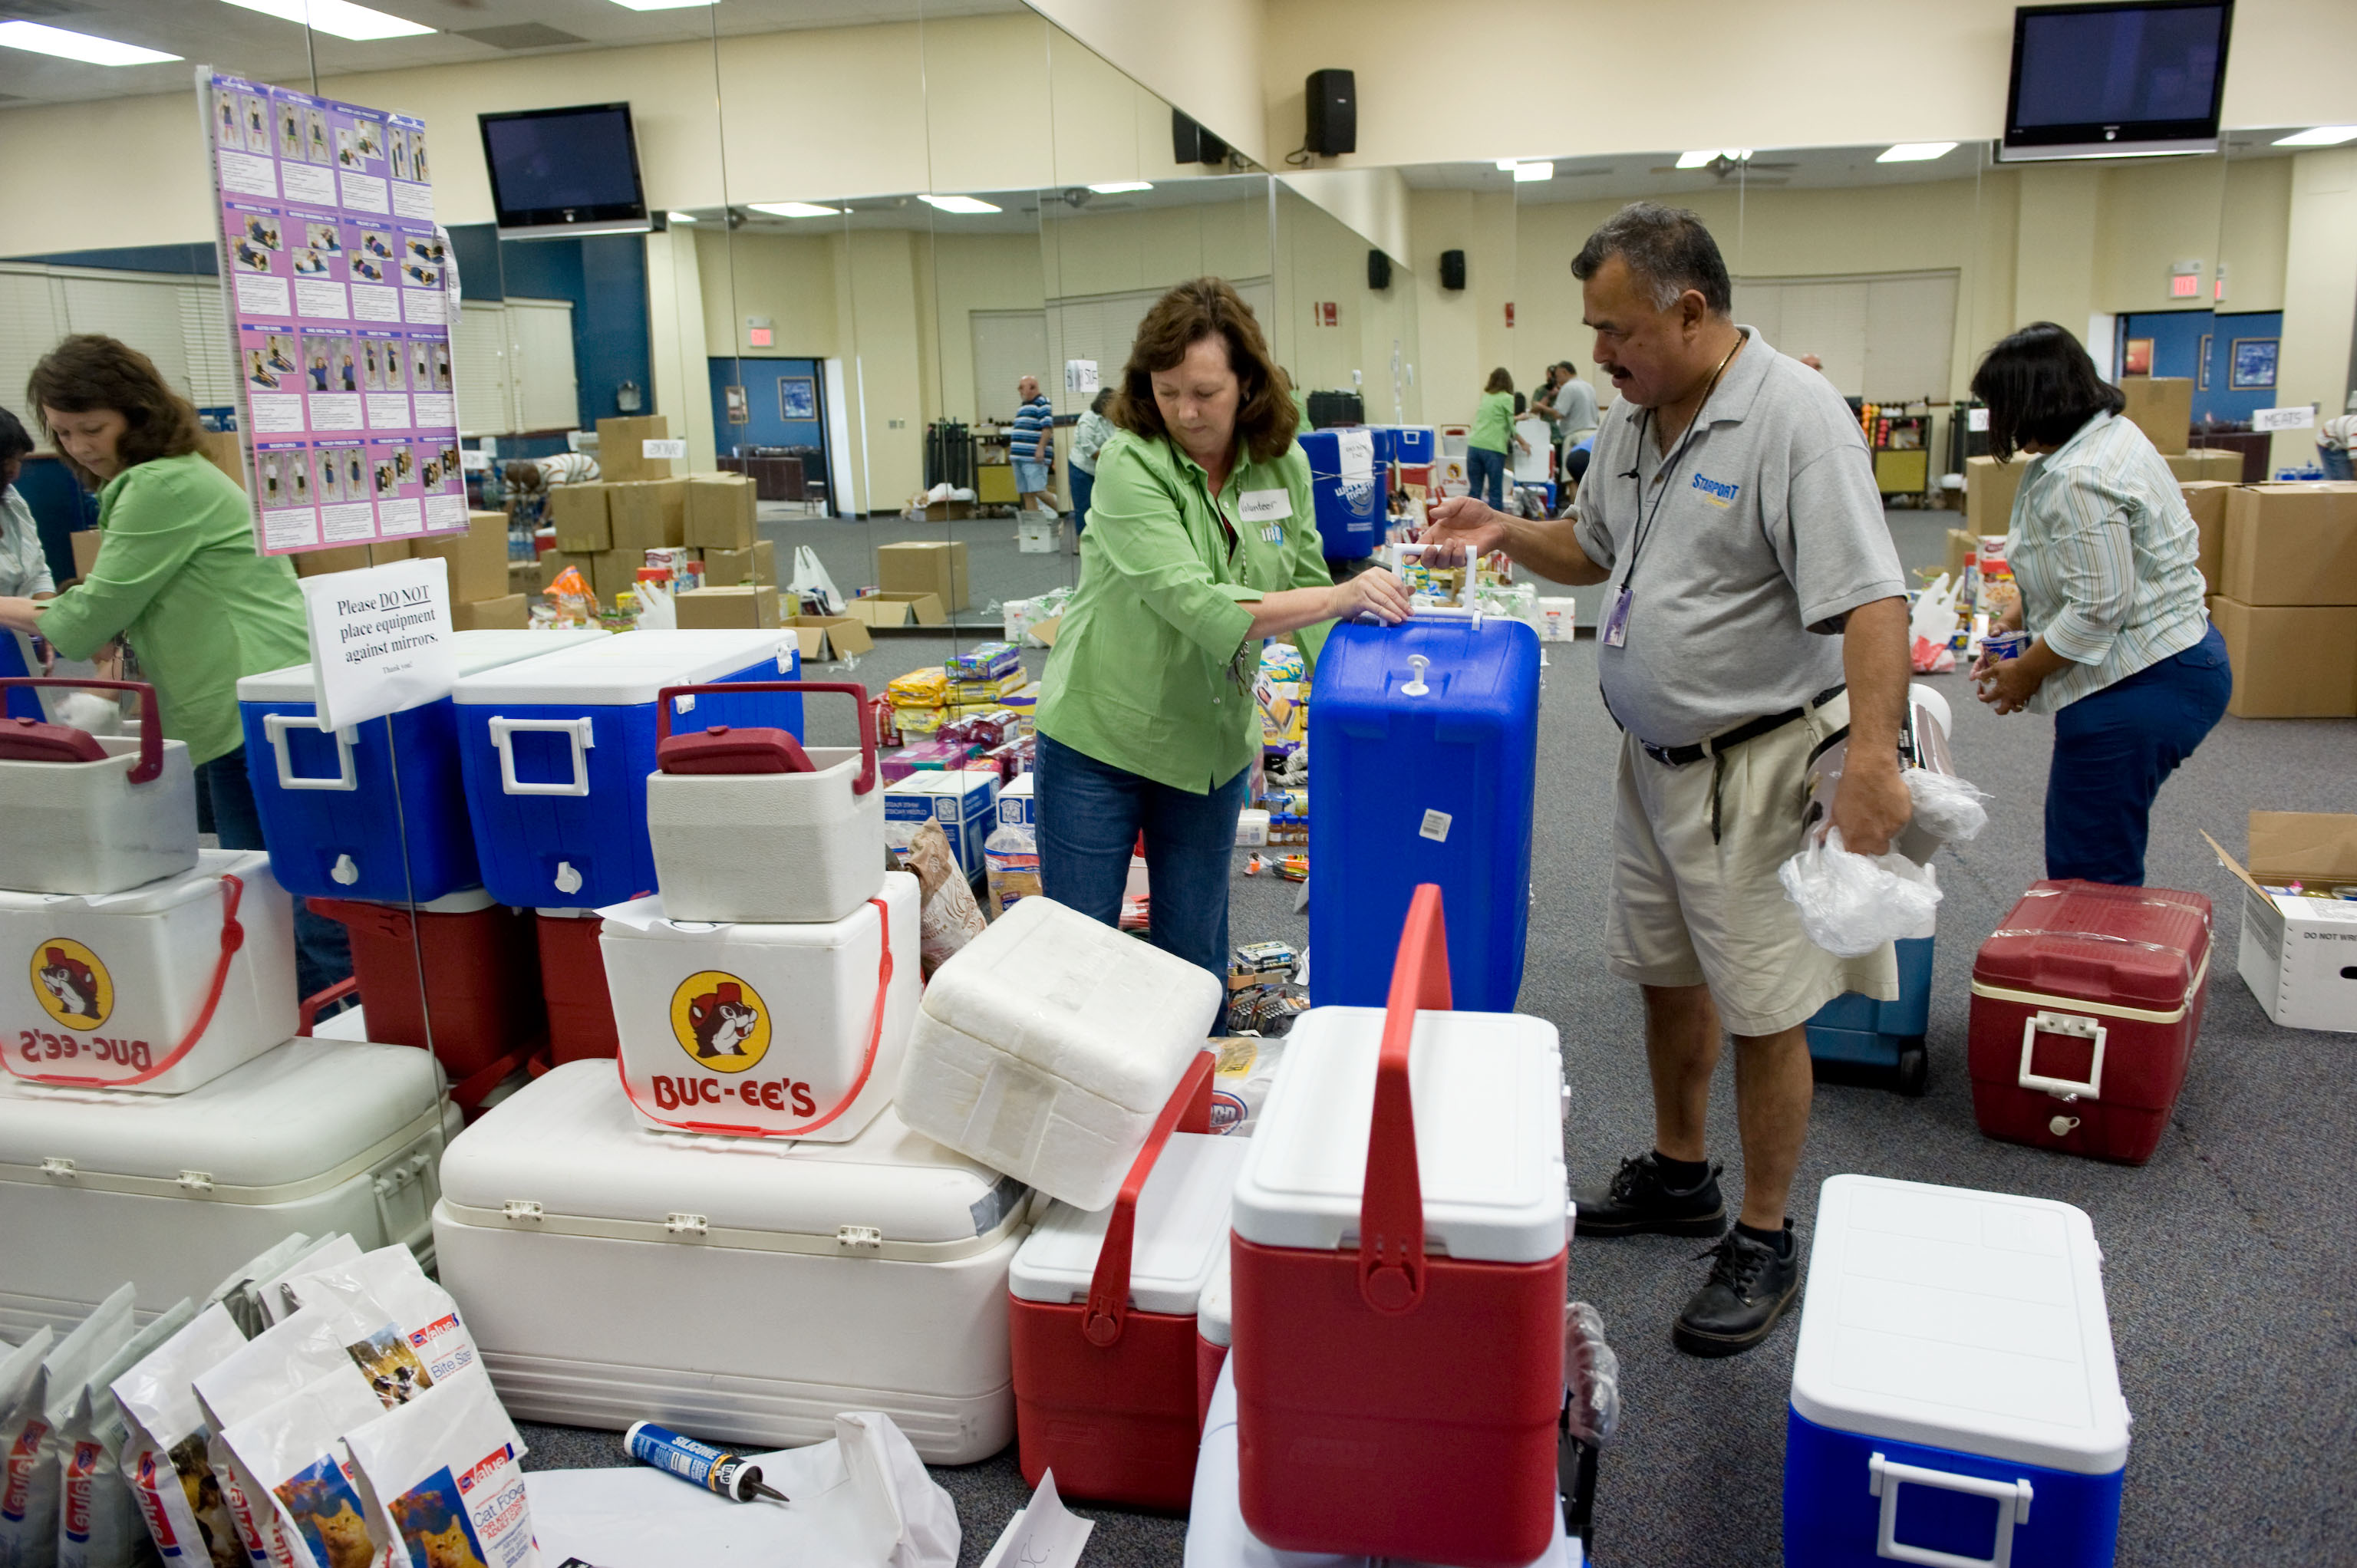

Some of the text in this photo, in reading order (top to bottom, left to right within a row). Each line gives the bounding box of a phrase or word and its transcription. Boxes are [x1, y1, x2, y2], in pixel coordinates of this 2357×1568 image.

[2264, 412, 2302, 427] MEATS
[1693, 473, 1739, 499] STARPORT
[338, 585, 431, 616] Please DO NOT
[340, 609, 437, 644] place equipment
[345, 631, 439, 664] against mirrors.
[382, 663, 400, 674] Thank
[651, 1076, 816, 1118] BUC-EE'S
[422, 1320, 454, 1342] Value
[430, 1360, 456, 1379] Bite
[672, 1436, 721, 1460] SILICONE
[470, 1456, 506, 1484] Value
[722, 1466, 733, 1483] DAP
[473, 1505, 497, 1527] Cat
[497, 1479, 525, 1509] Food
[479, 1521, 496, 1537] FOR
